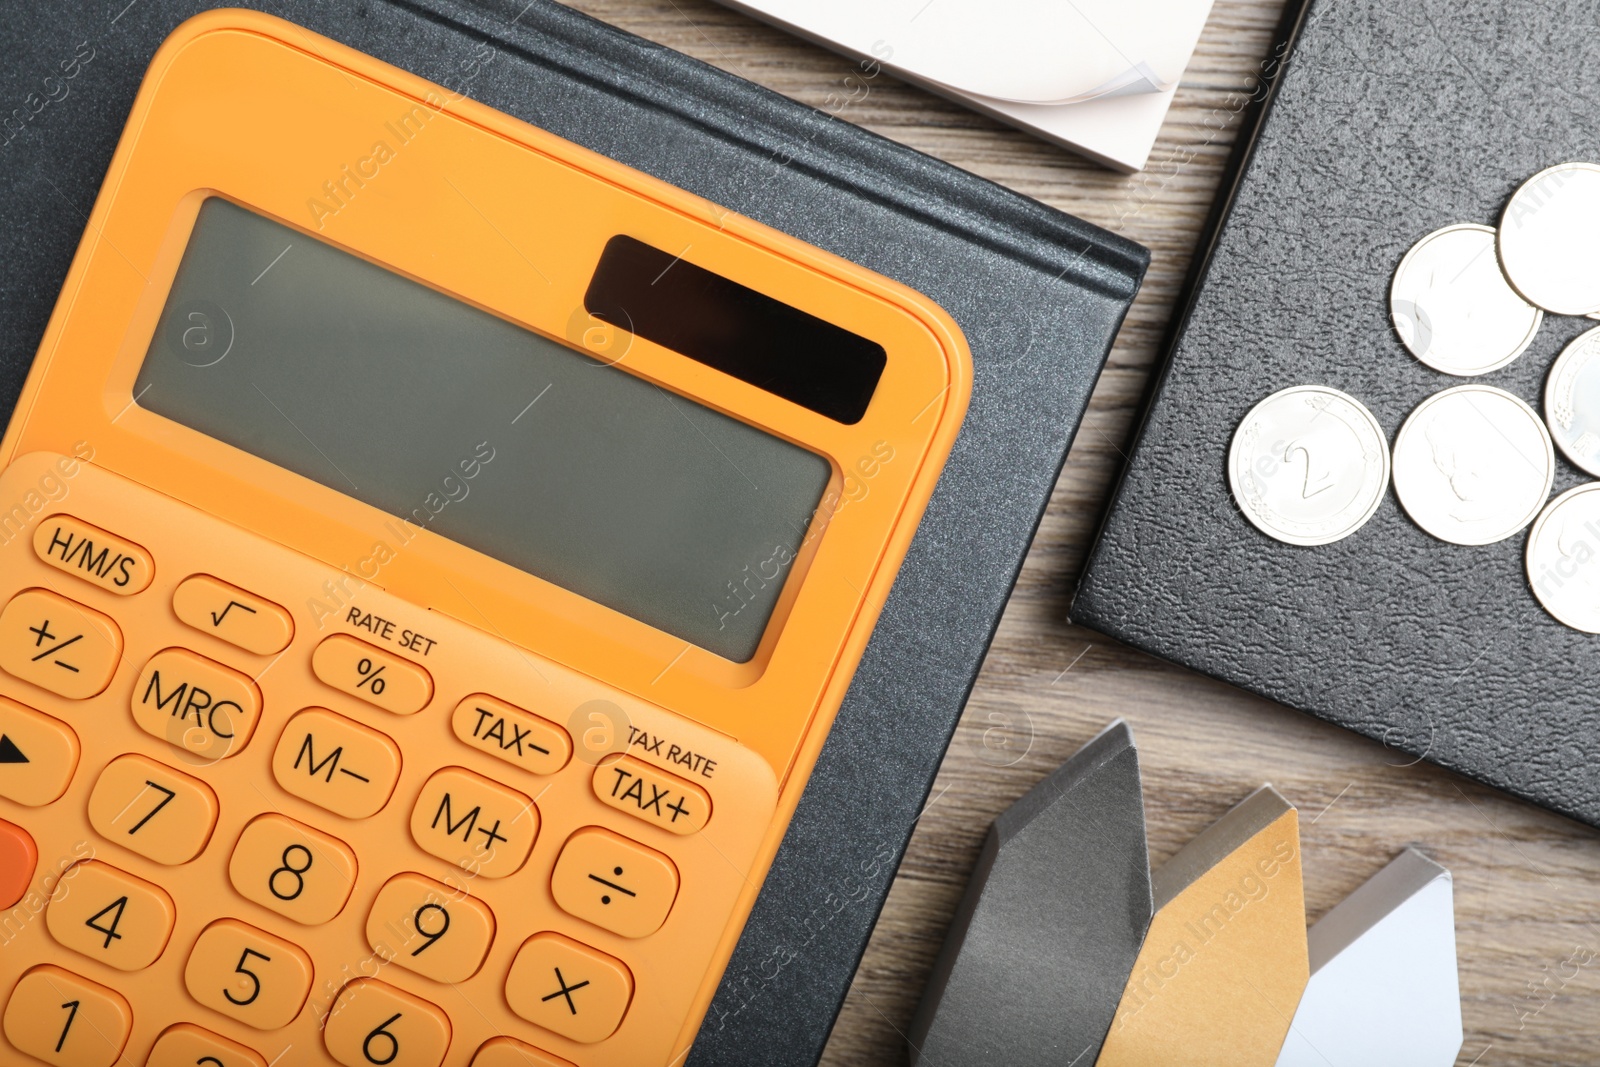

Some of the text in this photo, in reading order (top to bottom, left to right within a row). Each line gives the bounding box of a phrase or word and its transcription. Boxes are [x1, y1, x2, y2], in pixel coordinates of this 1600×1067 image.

[1284, 440, 1336, 499] 2
[47, 527, 136, 587] H/M/S
[345, 606, 438, 656] RATE SET
[356, 658, 386, 695] %
[142, 670, 244, 739] MRC
[472, 708, 550, 757] TAX-
[627, 725, 718, 779] TAX RATE
[128, 780, 176, 835] 7
[430, 792, 508, 850] M+
[611, 767, 690, 823] TAX+
[268, 844, 313, 901] 8
[85, 896, 129, 949] 4
[411, 903, 451, 957] 9
[222, 947, 271, 1006] 5
[54, 1000, 80, 1053] 1
[362, 1012, 403, 1066] 6
